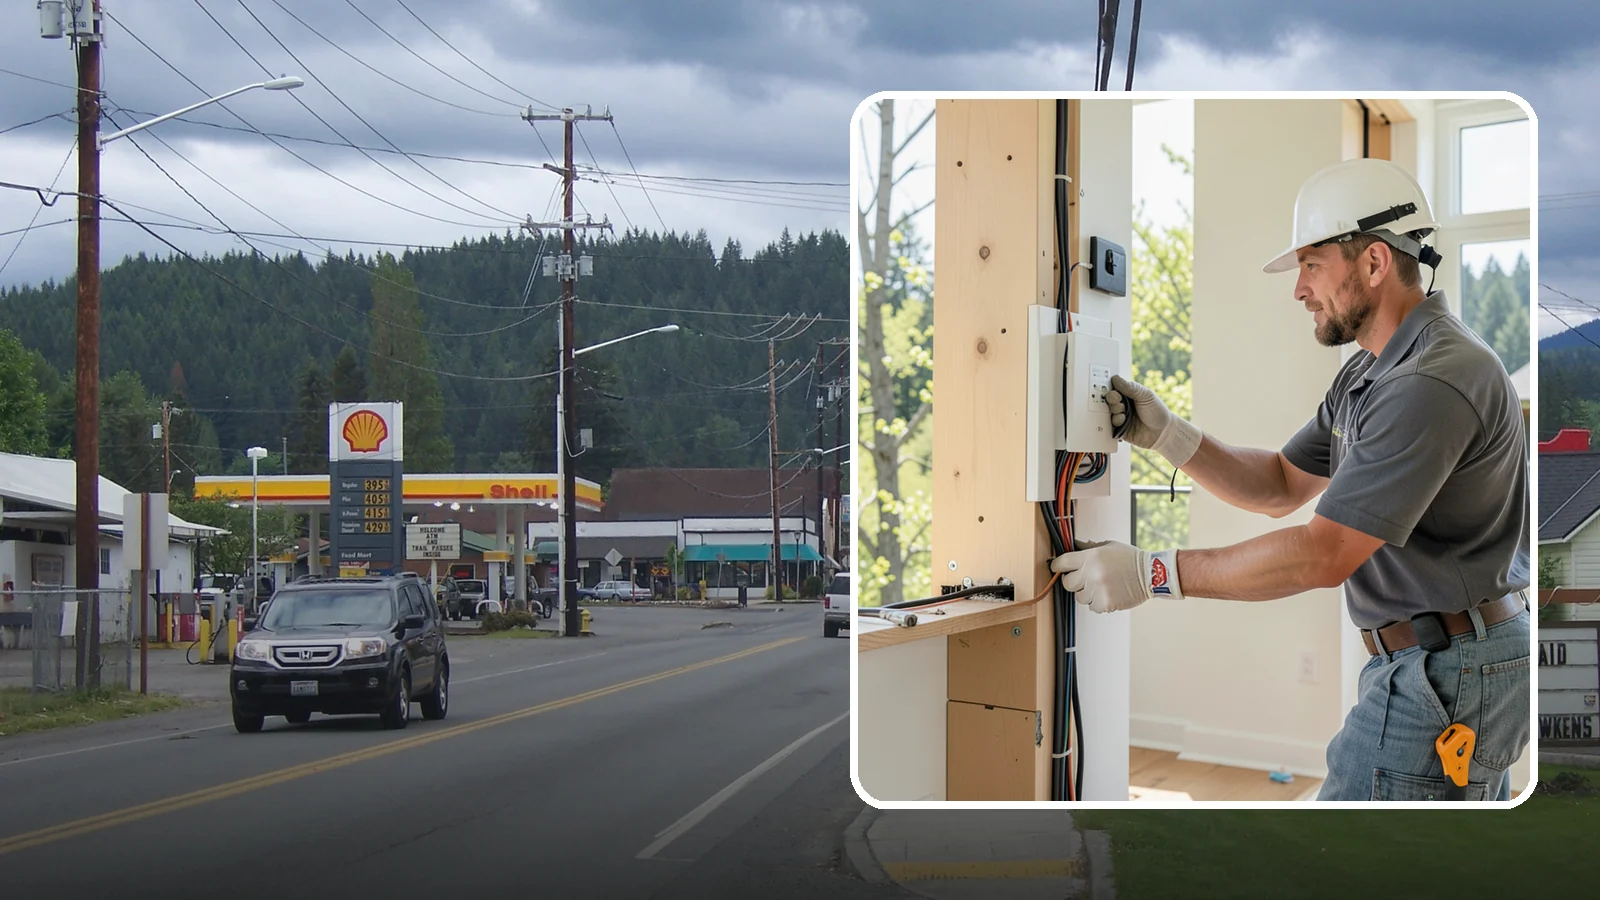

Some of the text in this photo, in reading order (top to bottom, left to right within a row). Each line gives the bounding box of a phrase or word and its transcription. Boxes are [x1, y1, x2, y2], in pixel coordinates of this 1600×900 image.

[365, 480, 383, 490] 395
[490, 485, 547, 499] Shell
[365, 494, 383, 504] 405
[365, 508, 383, 518] 415
[365, 522, 383, 532] 429
